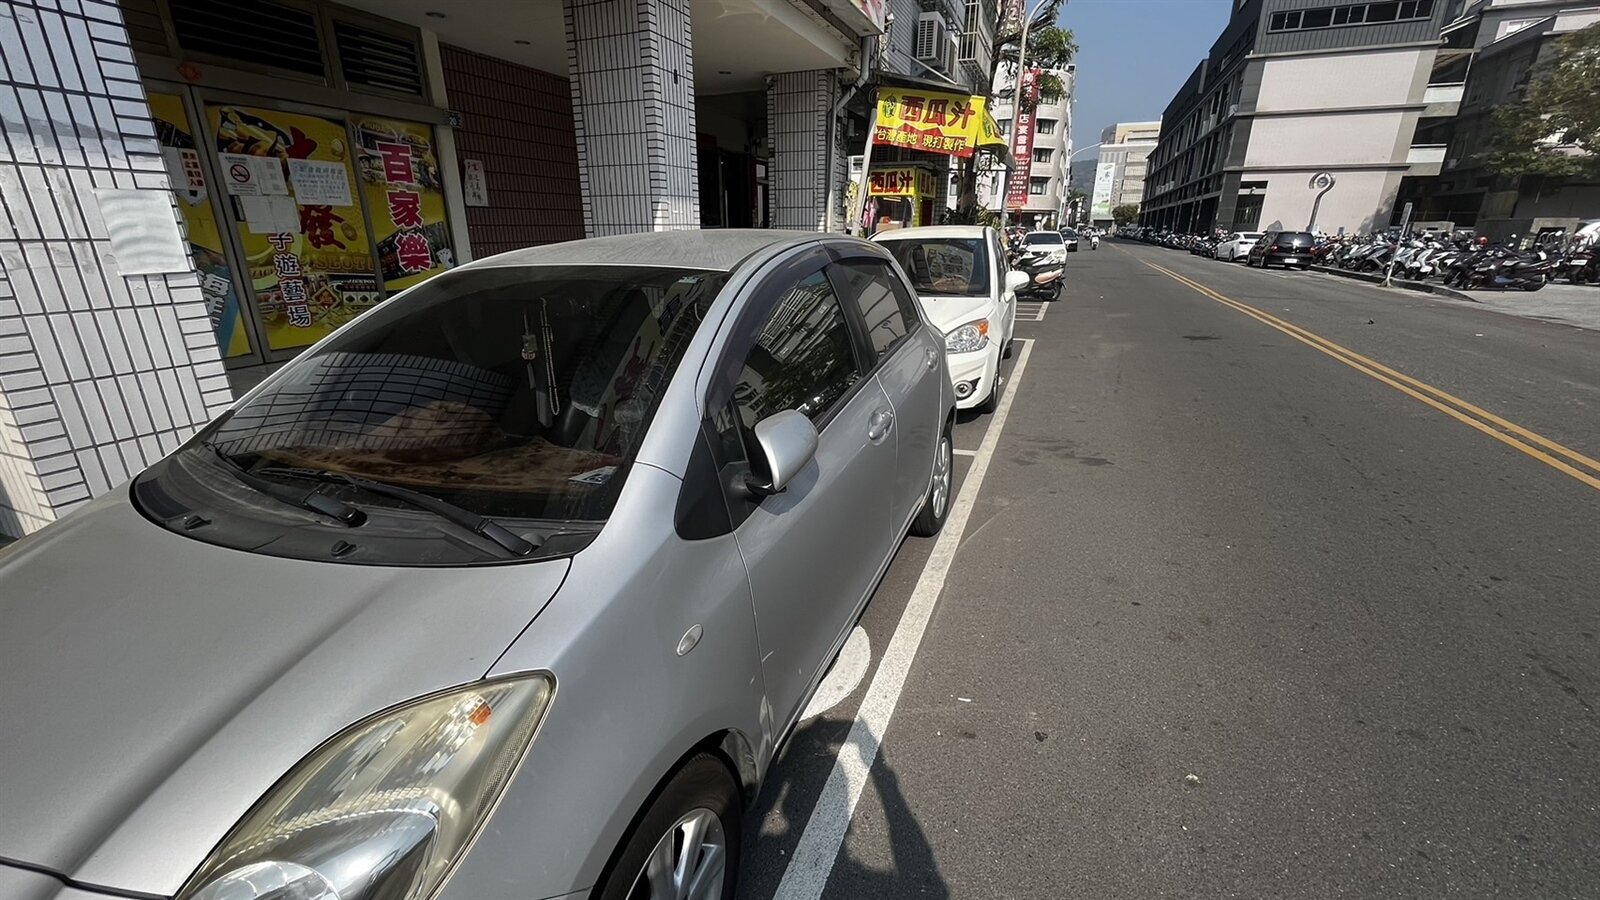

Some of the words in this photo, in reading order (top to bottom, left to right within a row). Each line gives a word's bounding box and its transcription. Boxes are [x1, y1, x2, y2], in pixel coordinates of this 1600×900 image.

[899, 95, 976, 130] 西瓜汁
[922, 134, 966, 152] 現打製作
[871, 170, 914, 194] 西瓜汁
[376, 140, 432, 272] 百家樂
[267, 232, 312, 327] 子遊藝場
